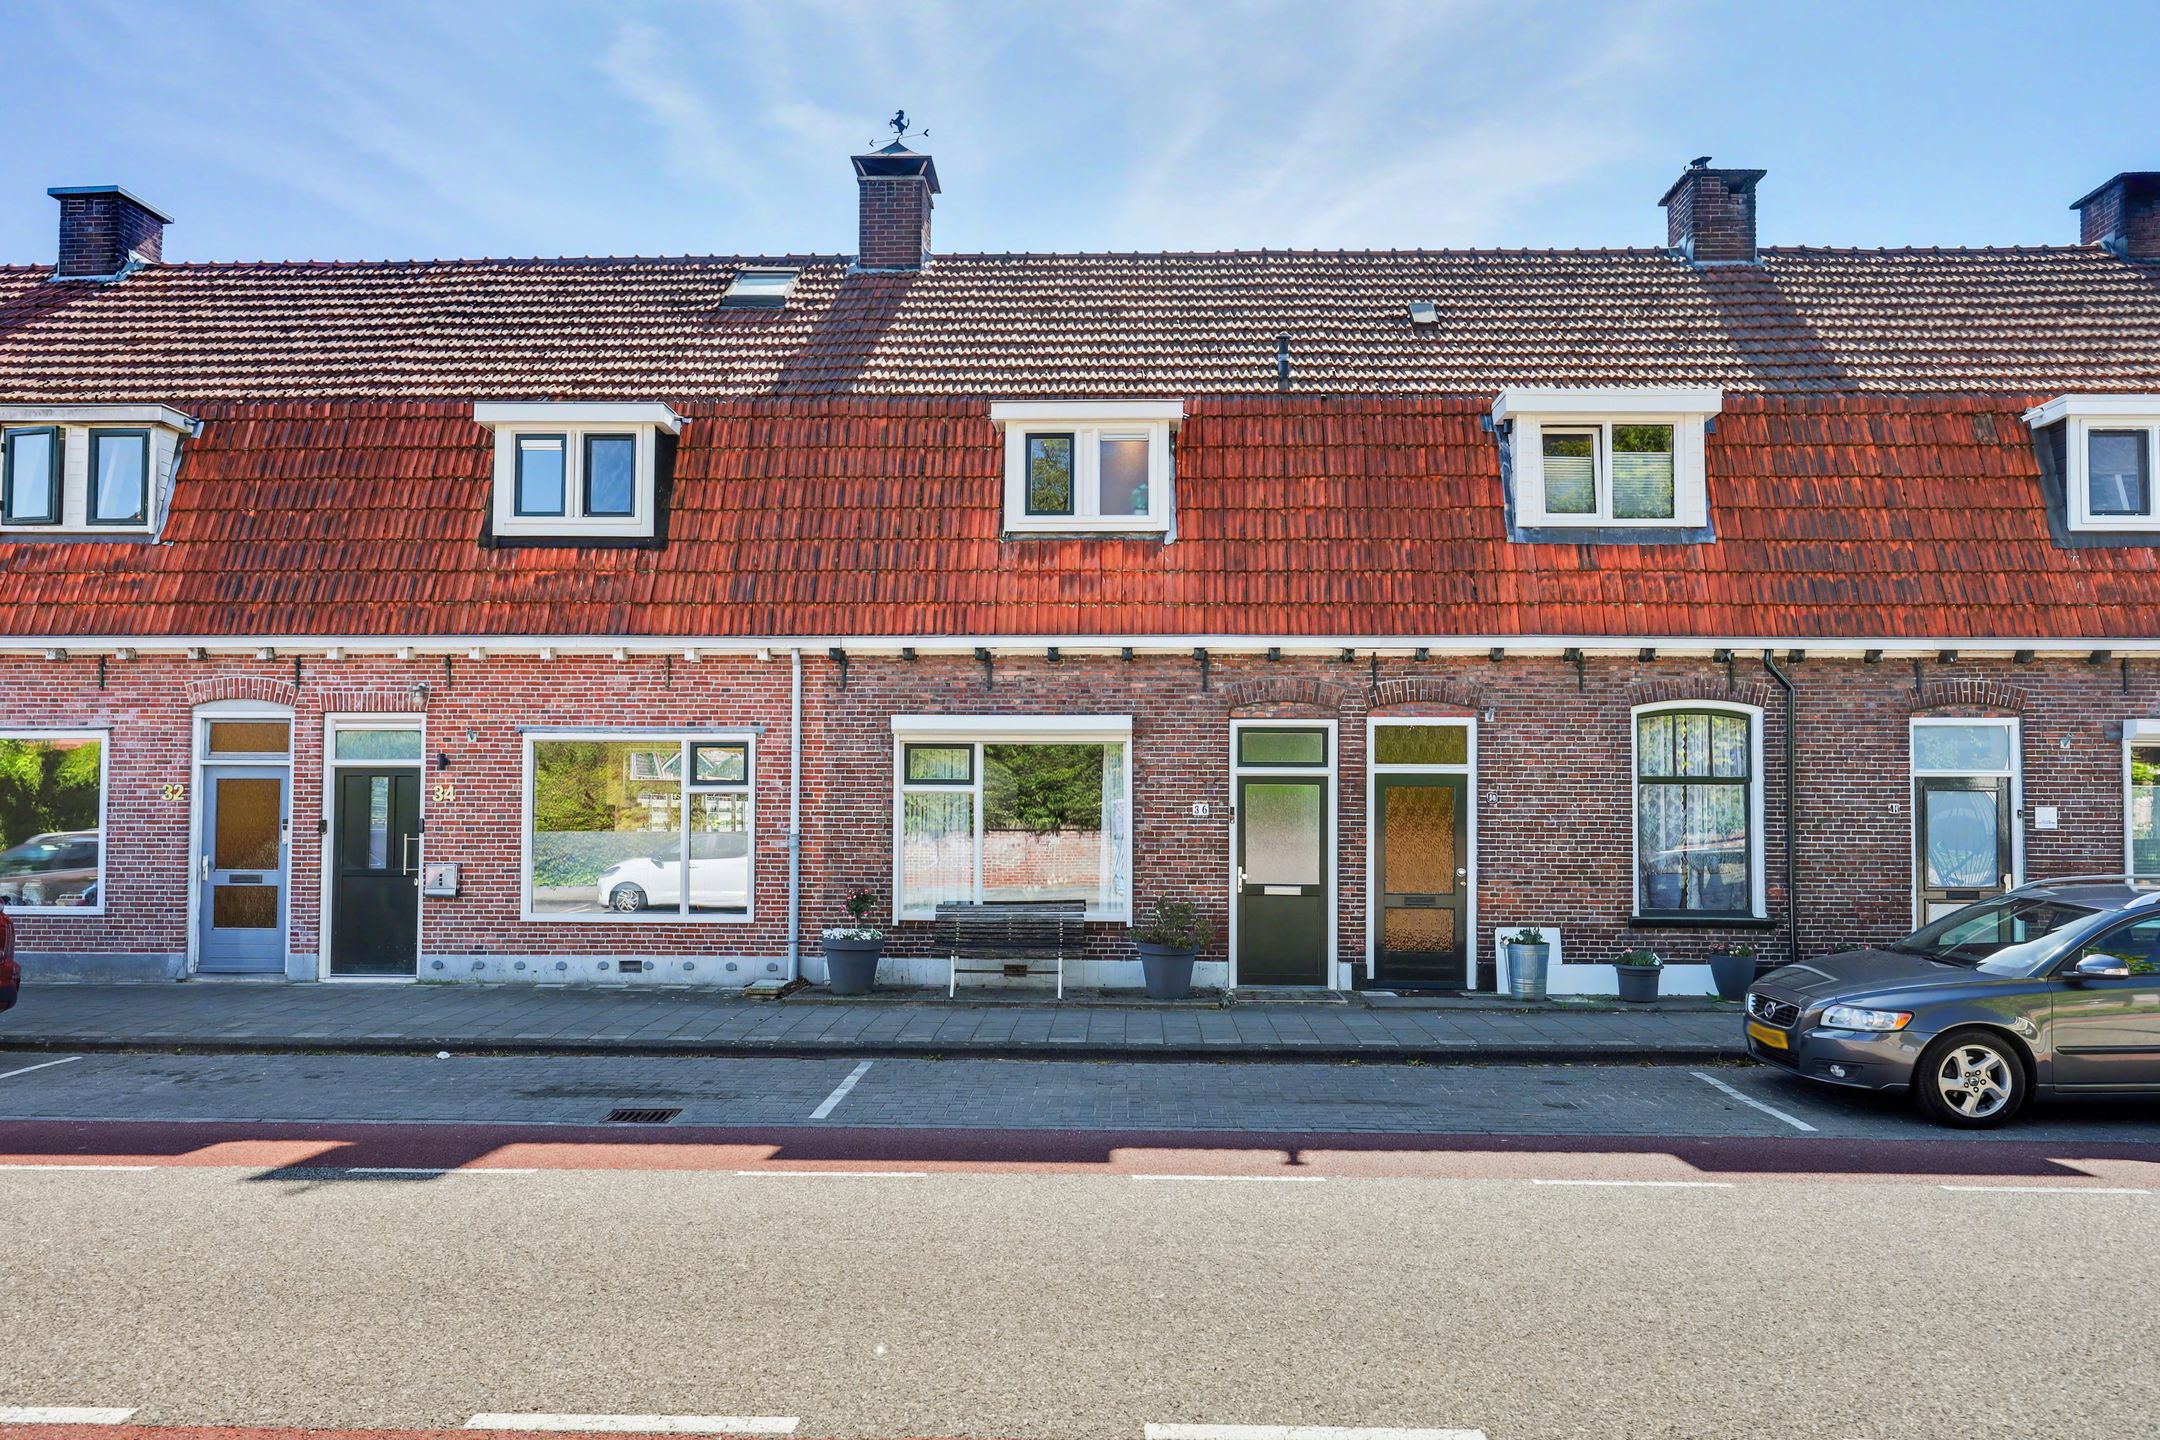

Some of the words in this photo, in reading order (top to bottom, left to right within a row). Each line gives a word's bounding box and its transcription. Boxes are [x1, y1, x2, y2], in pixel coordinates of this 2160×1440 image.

[161, 784, 185, 801] 32
[432, 784, 456, 802] 34
[1194, 805, 1208, 815] 36
